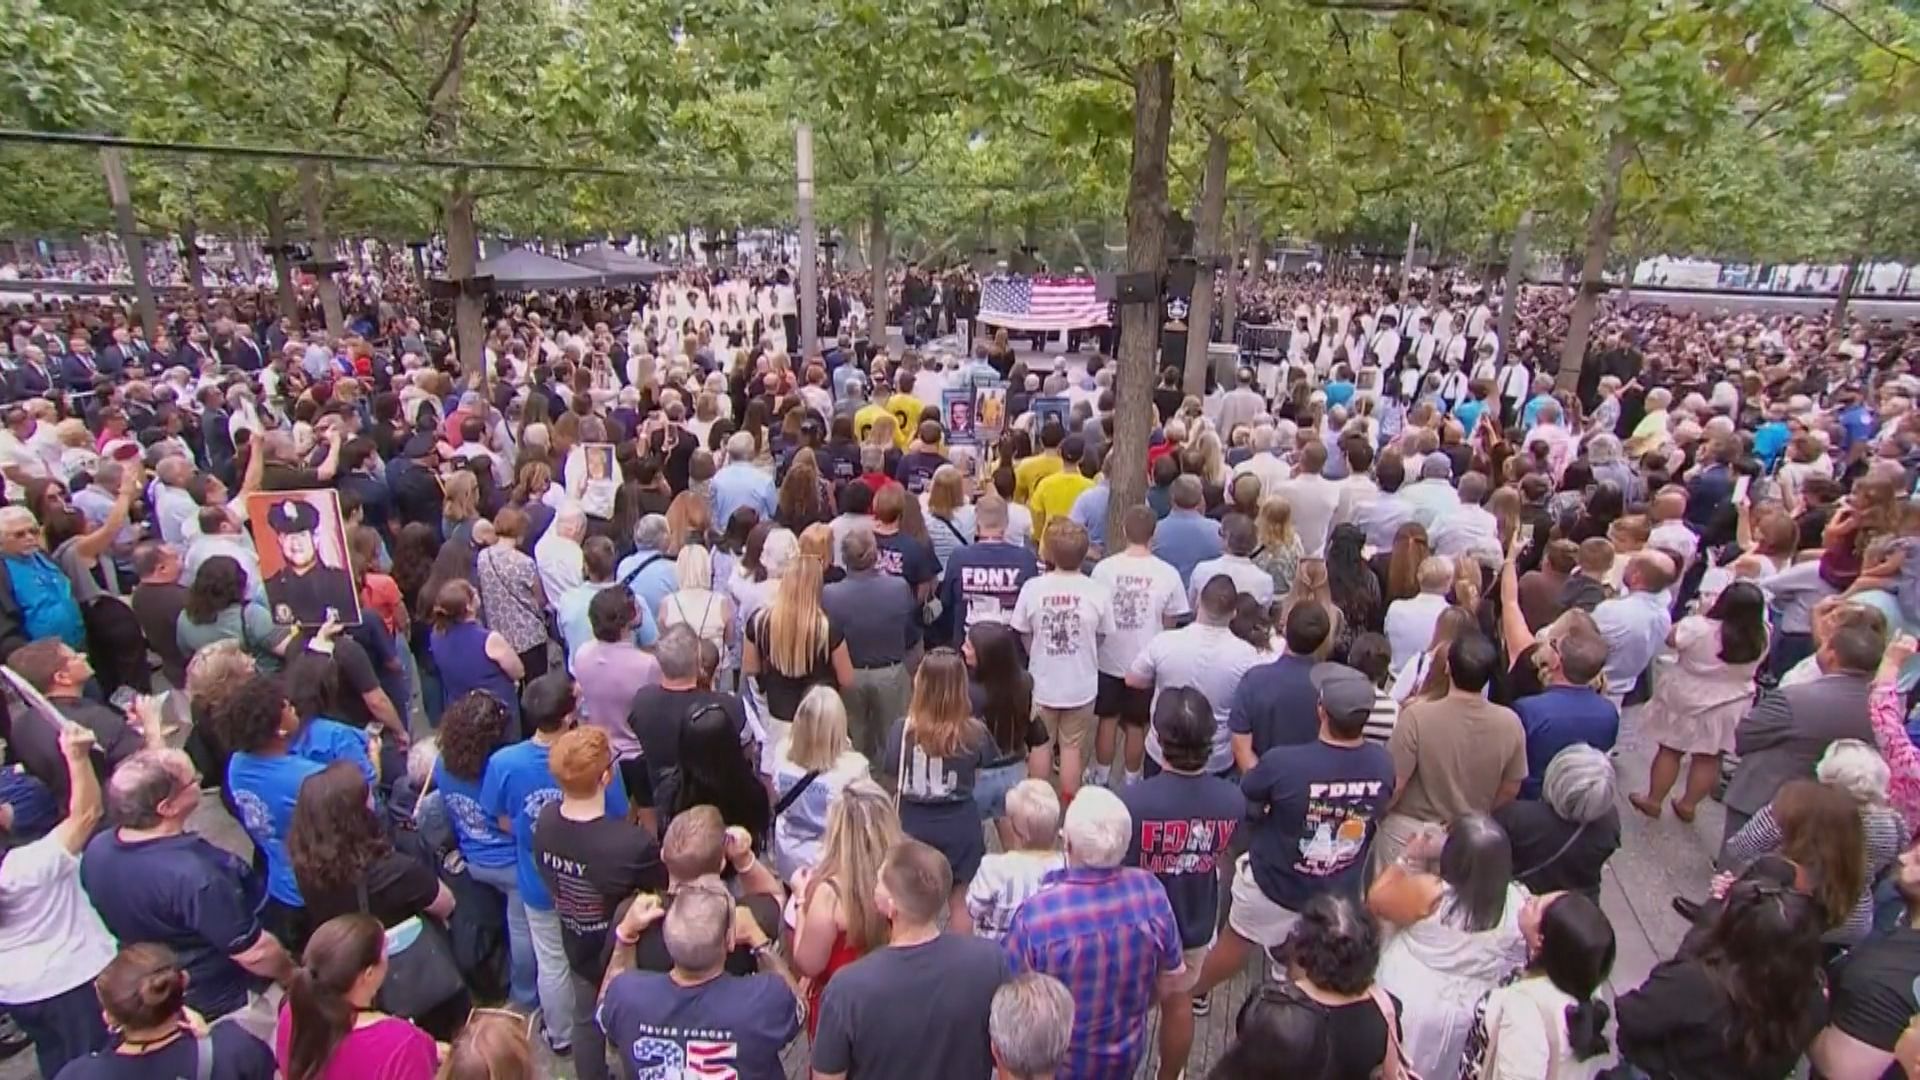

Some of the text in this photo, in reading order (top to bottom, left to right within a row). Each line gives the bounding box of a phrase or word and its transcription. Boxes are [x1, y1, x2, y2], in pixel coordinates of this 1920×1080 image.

[961, 567, 1020, 587] FDNY
[1116, 575, 1152, 588] FDNY
[1042, 595, 1081, 607] FDNY
[1310, 781, 1382, 798] FDNY
[1141, 818, 1237, 853] FDNY
[543, 851, 587, 877] FDNY
[640, 1023, 732, 1040] NEVER FORGET
